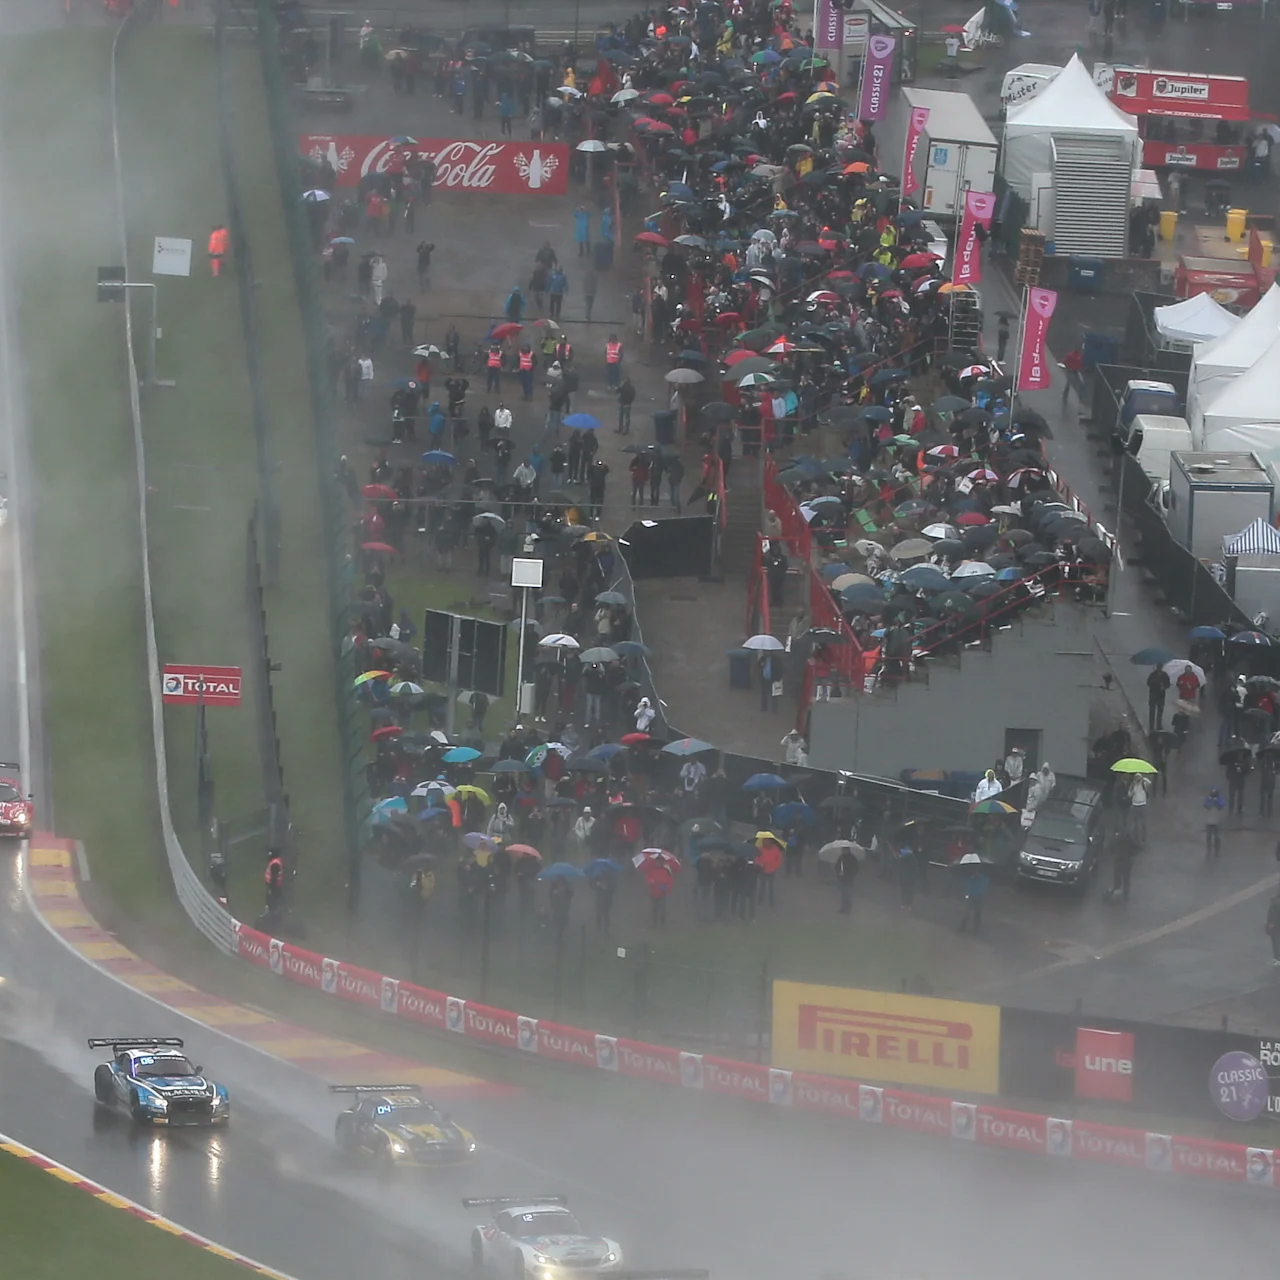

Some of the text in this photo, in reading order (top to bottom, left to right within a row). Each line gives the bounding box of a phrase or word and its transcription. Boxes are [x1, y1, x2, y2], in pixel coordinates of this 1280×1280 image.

[869, 64, 884, 113] CLASSIC 21
[1170, 83, 1206, 95] Jupiler
[184, 679, 239, 694] TOTAL
[282, 951, 322, 981] TOTAL
[337, 969, 380, 1000] TOTAL
[398, 988, 444, 1020] TOTAL
[465, 1009, 516, 1041] TOTAL
[797, 1003, 974, 1072] PIRELLI
[539, 1028, 594, 1058] TOTAL
[1260, 1041, 1272, 1051] LA
[620, 1046, 678, 1077] TOTAL
[1084, 1055, 1133, 1075] une
[1217, 1068, 1264, 1084] CLASSIC
[705, 1064, 765, 1094] TOTAL
[1219, 1085, 1238, 1103] 21
[377, 1105, 391, 1115] 04
[887, 1097, 949, 1128] TOTAL
[978, 1113, 1045, 1144] TOTAL
[522, 1214, 534, 1223] 12
